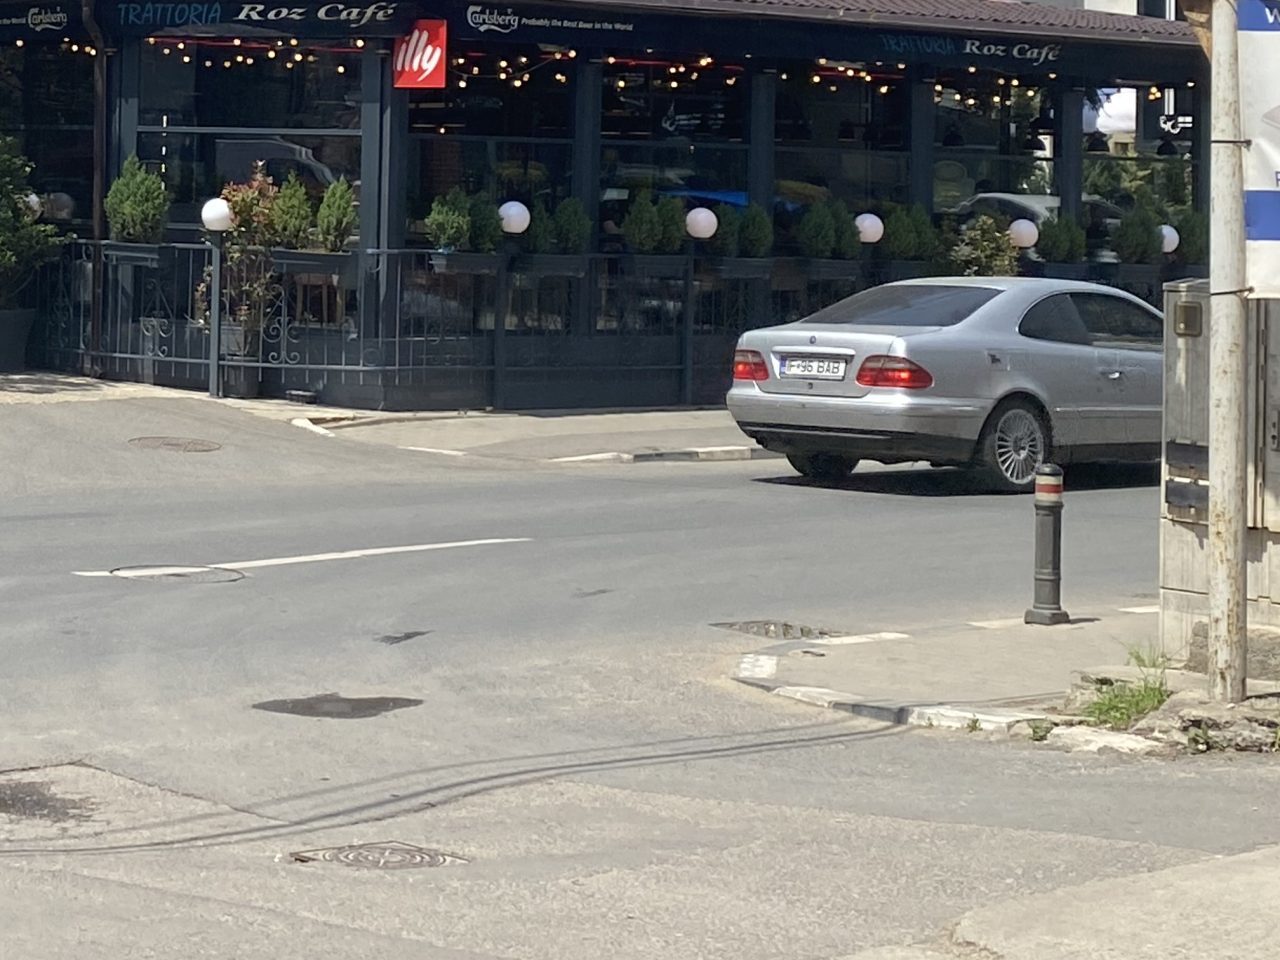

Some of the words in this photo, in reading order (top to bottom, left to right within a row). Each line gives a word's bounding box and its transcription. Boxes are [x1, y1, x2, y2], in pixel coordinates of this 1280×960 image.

[118, 1, 221, 26] TRATTORIA
[233, 3, 308, 21] Roz
[317, 1, 398, 28] Café
[466, 5, 519, 33] Carlsberg
[394, 29, 442, 82] illy
[962, 38, 1007, 58] Roz
[1012, 42, 1062, 66] Café
